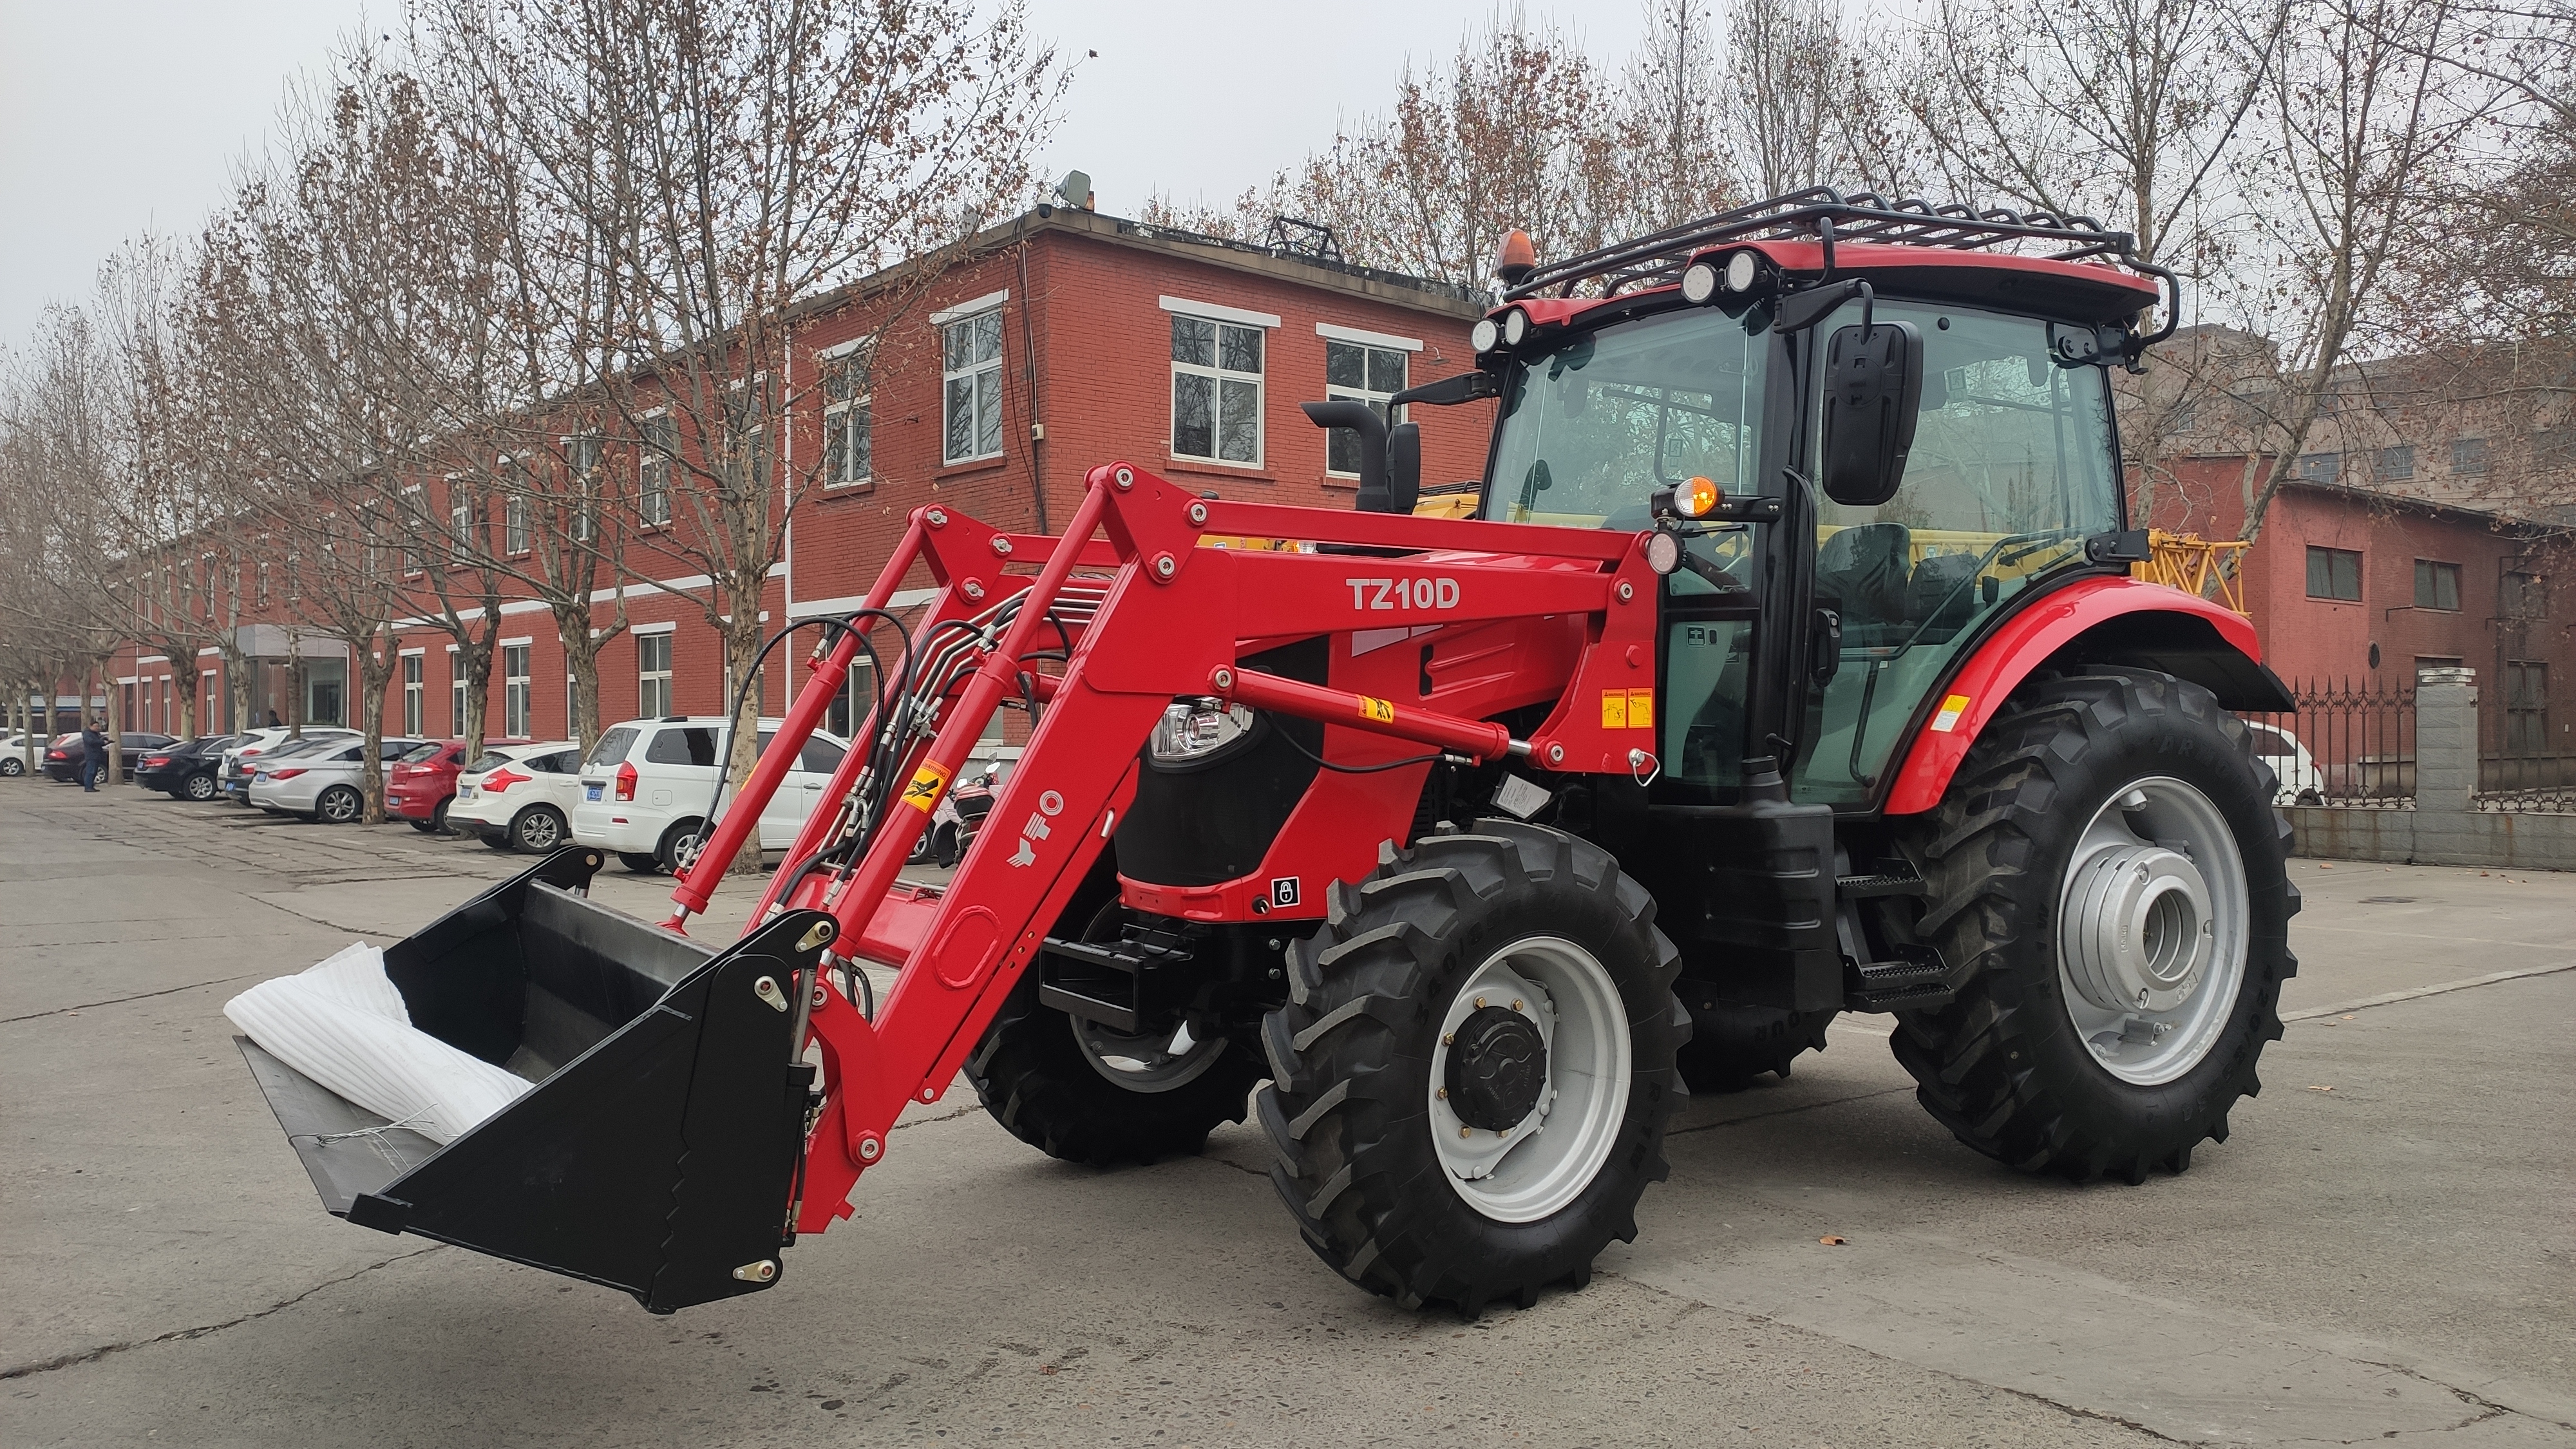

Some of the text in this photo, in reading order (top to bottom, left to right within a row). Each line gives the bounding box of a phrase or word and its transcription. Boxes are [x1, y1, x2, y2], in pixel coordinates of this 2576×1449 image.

[1346, 578, 1460, 609] TZ10D
[925, 763, 947, 777] WARNING
[1006, 790, 1064, 868] YTO
